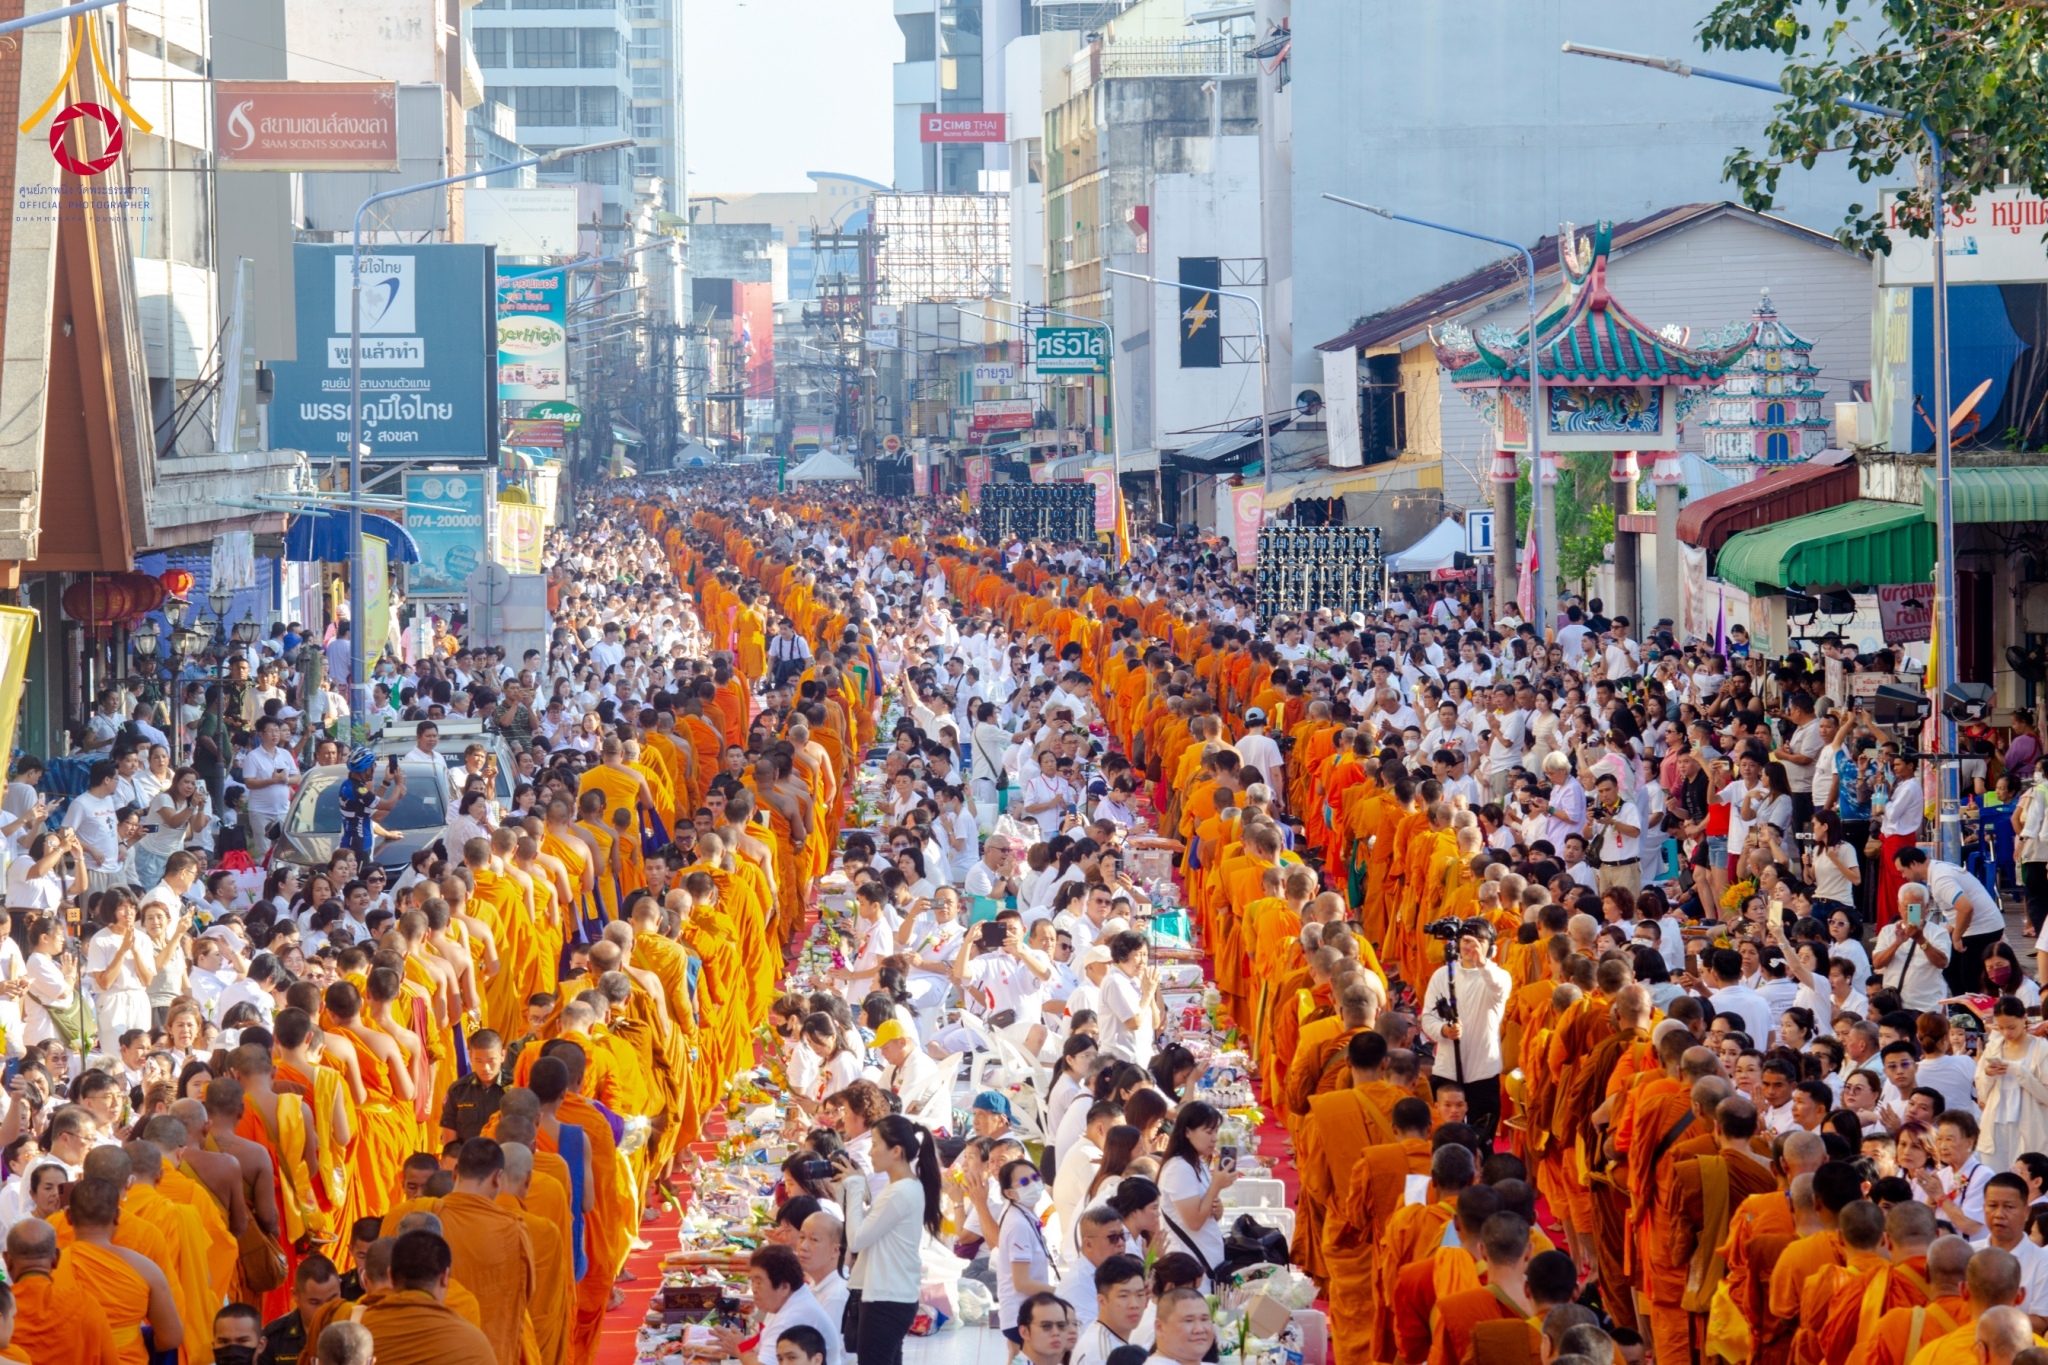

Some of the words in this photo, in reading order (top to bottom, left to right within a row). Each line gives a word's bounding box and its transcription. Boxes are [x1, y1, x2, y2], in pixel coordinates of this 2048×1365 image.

[943, 120, 971, 130] CIMB
[973, 120, 996, 130] THAI
[261, 140, 287, 149] SIAM
[290, 140, 326, 149] SCENTS
[330, 140, 387, 149] SONGKHLA
[1038, 330, 1104, 356] ศรีวิไล
[334, 342, 418, 364] พูแล้วทำ
[976, 366, 1014, 384] ถ่ายรูป
[322, 378, 430, 390] ศูนย์ปสานงานตัวแทน
[363, 431, 372, 442] 2
[378, 430, 418, 442] สงขลา
[409, 515, 482, 527] 074-200000
